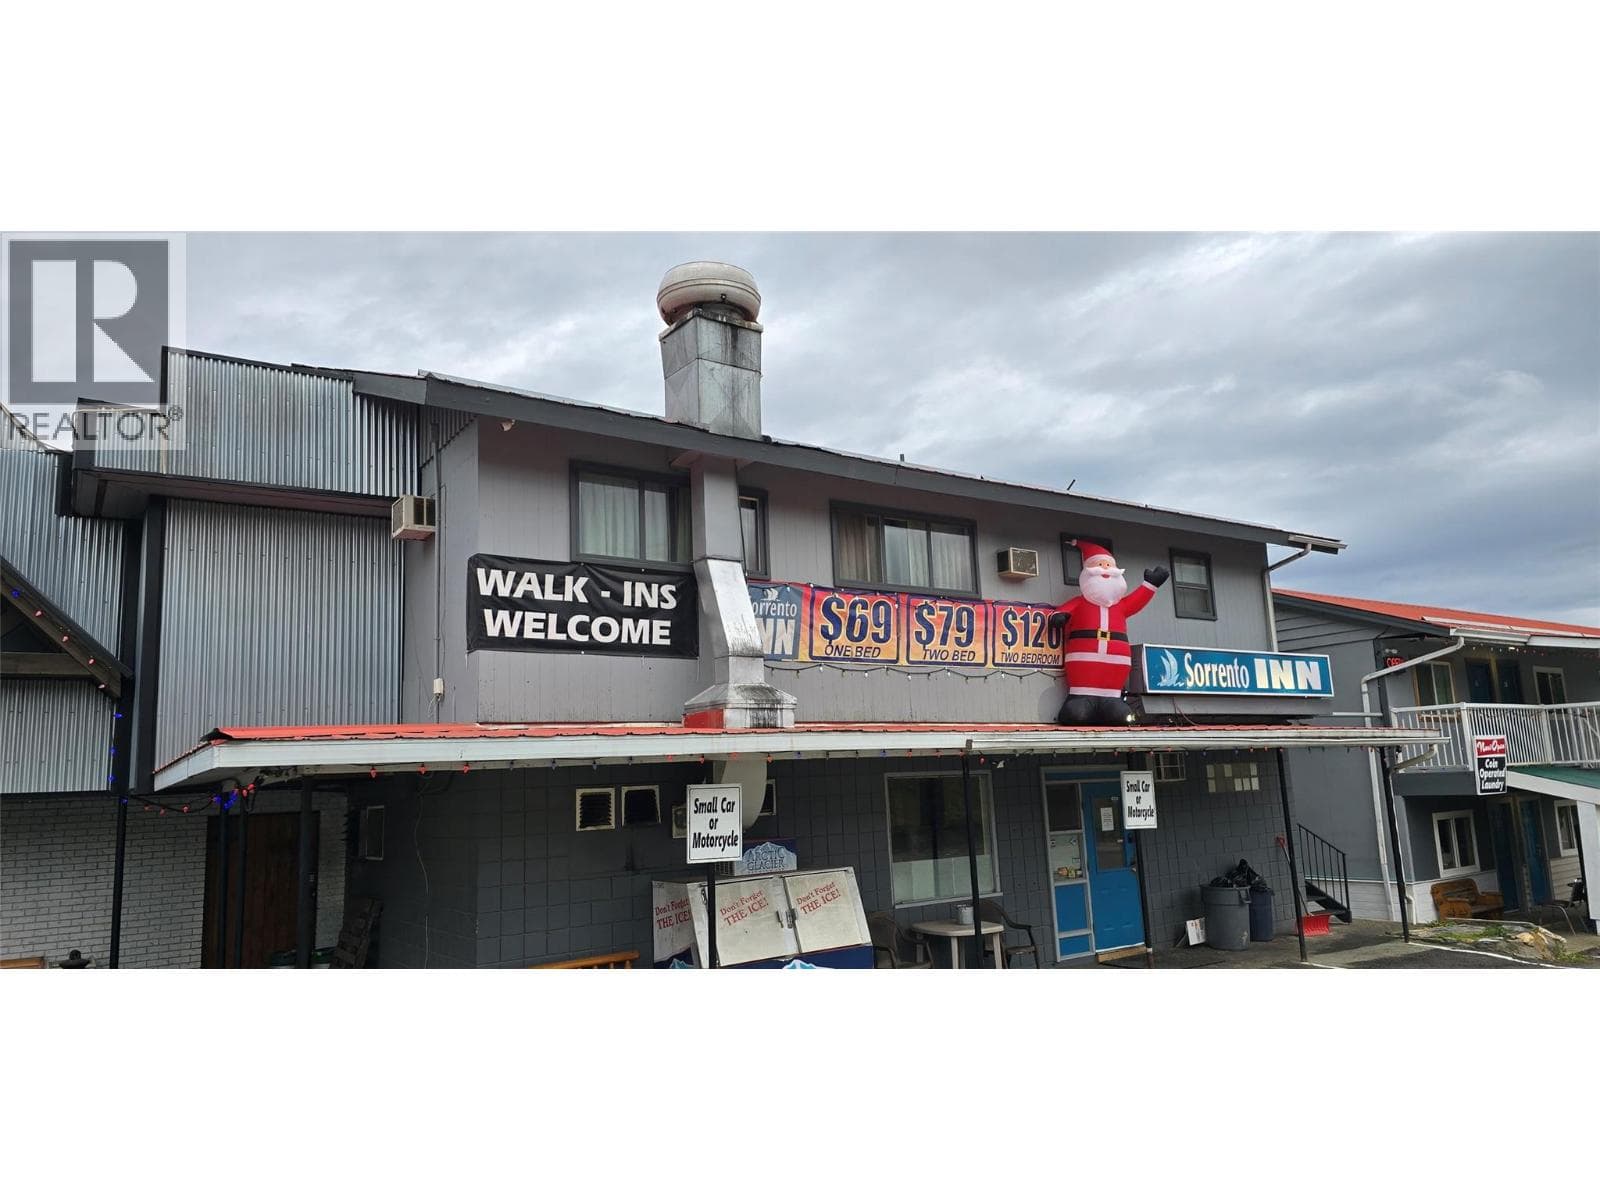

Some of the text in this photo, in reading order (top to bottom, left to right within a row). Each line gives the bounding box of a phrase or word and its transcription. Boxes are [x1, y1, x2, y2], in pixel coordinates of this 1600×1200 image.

[476, 567, 589, 603] WALK
[623, 580, 677, 610] INS
[752, 601, 798, 617] orrento
[483, 608, 672, 646] WELCOME
[820, 593, 893, 646] $69
[914, 601, 975, 650] $79
[757, 617, 796, 655] NN
[824, 644, 881, 658] ONE BED
[923, 648, 976, 662] TWO BED
[1001, 652, 1060, 664] TWO BEDROOM
[1184, 652, 1322, 690] Sorrento INN
[1484, 758, 1498, 769] Coin
[1479, 767, 1506, 780] Operated
[1126, 780, 1151, 793] Small Car
[1481, 779, 1504, 791] Laundry
[694, 796, 736, 814] Small Car
[1135, 795, 1141, 805] or
[1127, 805, 1154, 821] Motorcycle
[709, 818, 718, 830] or
[692, 830, 739, 852] Motorcycle
[748, 846, 785, 861] ARCTIC
[747, 859, 785, 871] GLACIER
[796, 882, 836, 904] Don't Forget
[720, 888, 764, 916] Don't Forget
[800, 889, 841, 914] THE ICE!
[724, 897, 769, 926] THE ICE!
[657, 916, 673, 930] THE
